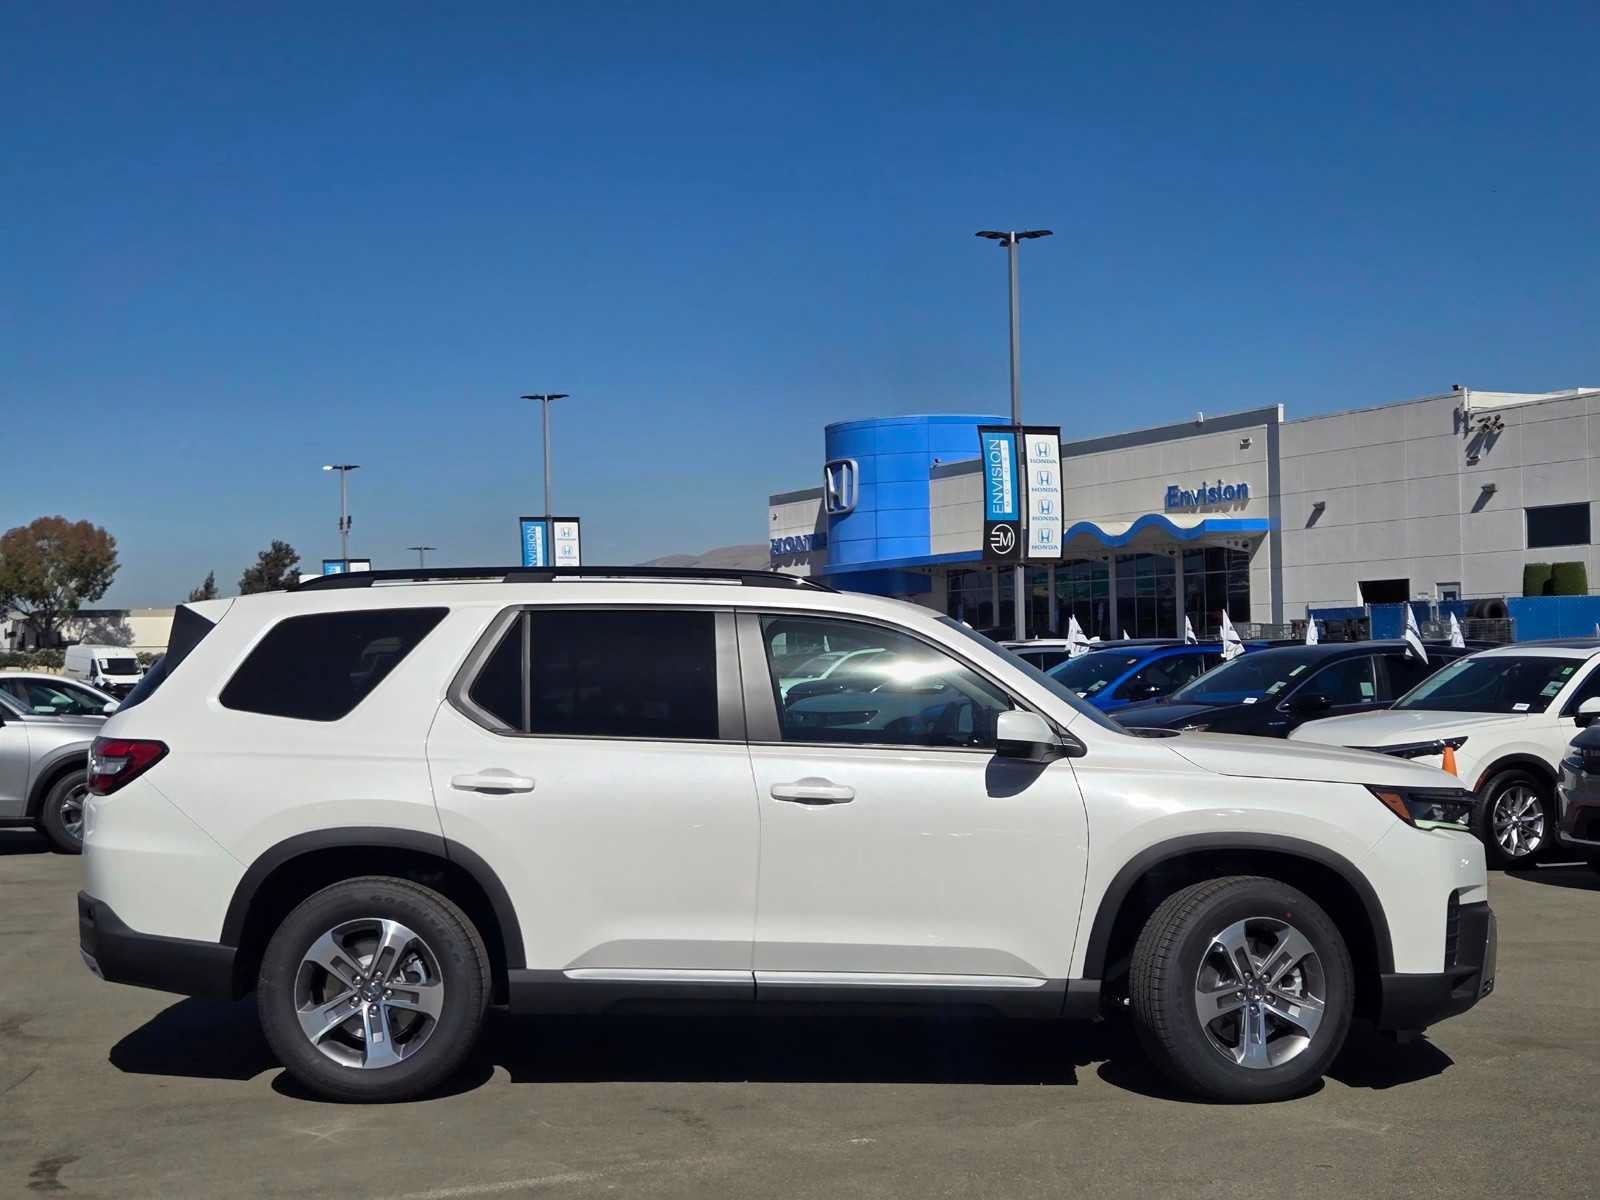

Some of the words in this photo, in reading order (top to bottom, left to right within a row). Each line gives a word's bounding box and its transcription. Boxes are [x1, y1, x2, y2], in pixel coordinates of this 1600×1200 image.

[988, 439, 1004, 514] ENVISION
[1167, 480, 1249, 507] Envision
[527, 525, 537, 567] NVISION
